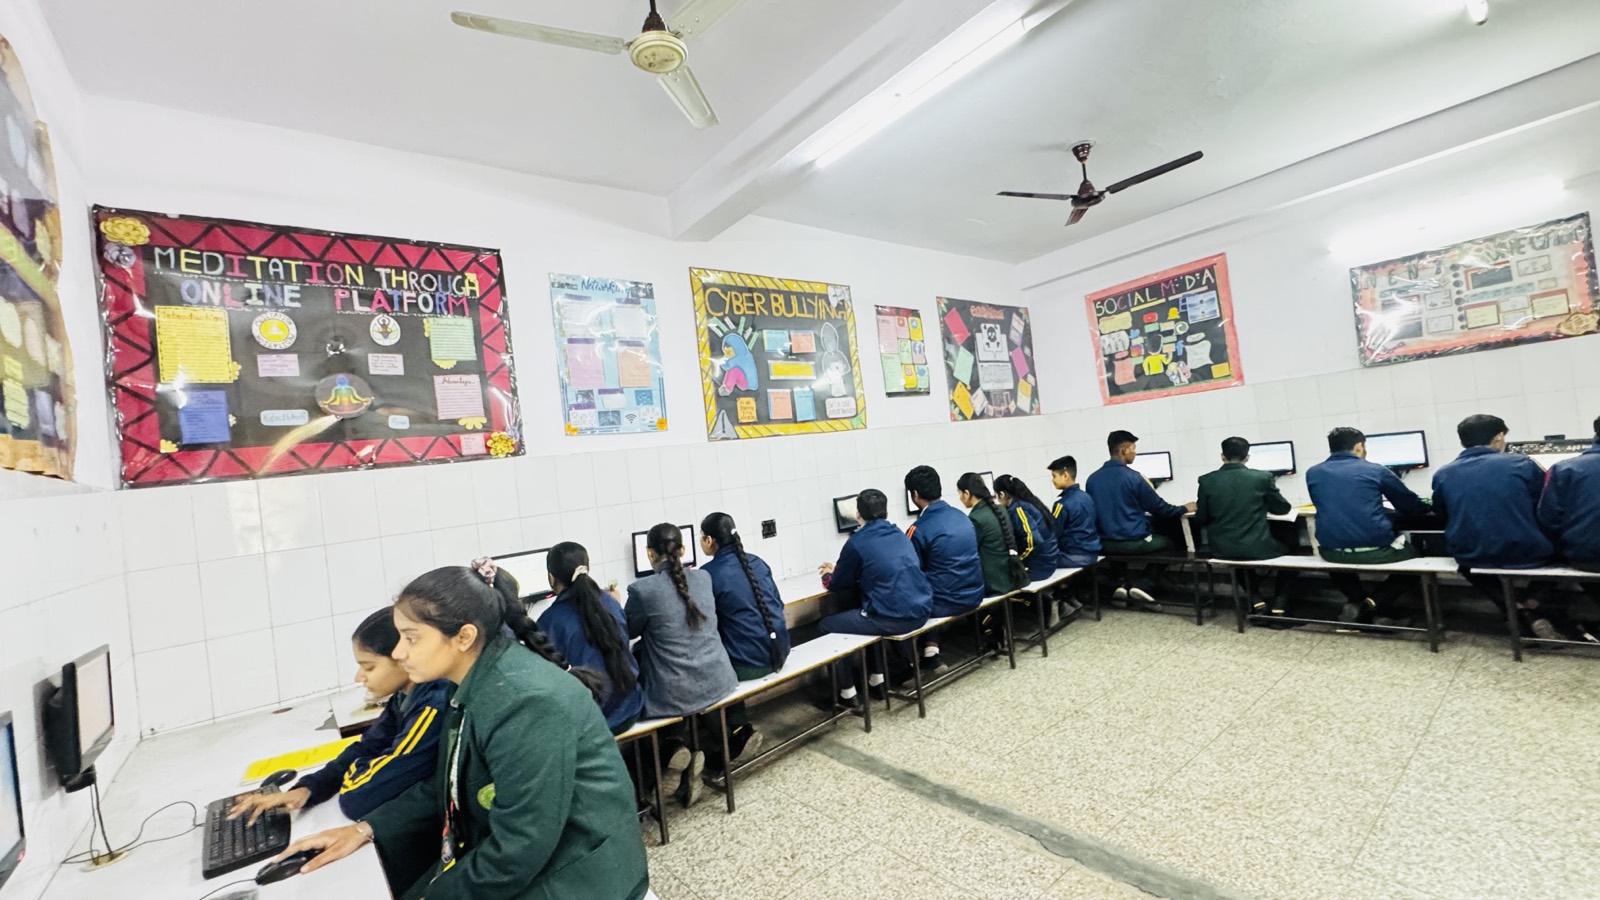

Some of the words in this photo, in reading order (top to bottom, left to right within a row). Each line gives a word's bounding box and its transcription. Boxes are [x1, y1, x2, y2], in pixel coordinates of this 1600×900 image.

[154, 247, 364, 286] MEDITATION
[375, 267, 480, 297] THROUGH
[1095, 288, 1157, 317] SOCIAL
[1160, 268, 1214, 297] MDA
[180, 279, 301, 308] ONLINE
[335, 288, 470, 316] PLATFORM
[704, 287, 768, 317] CYBER
